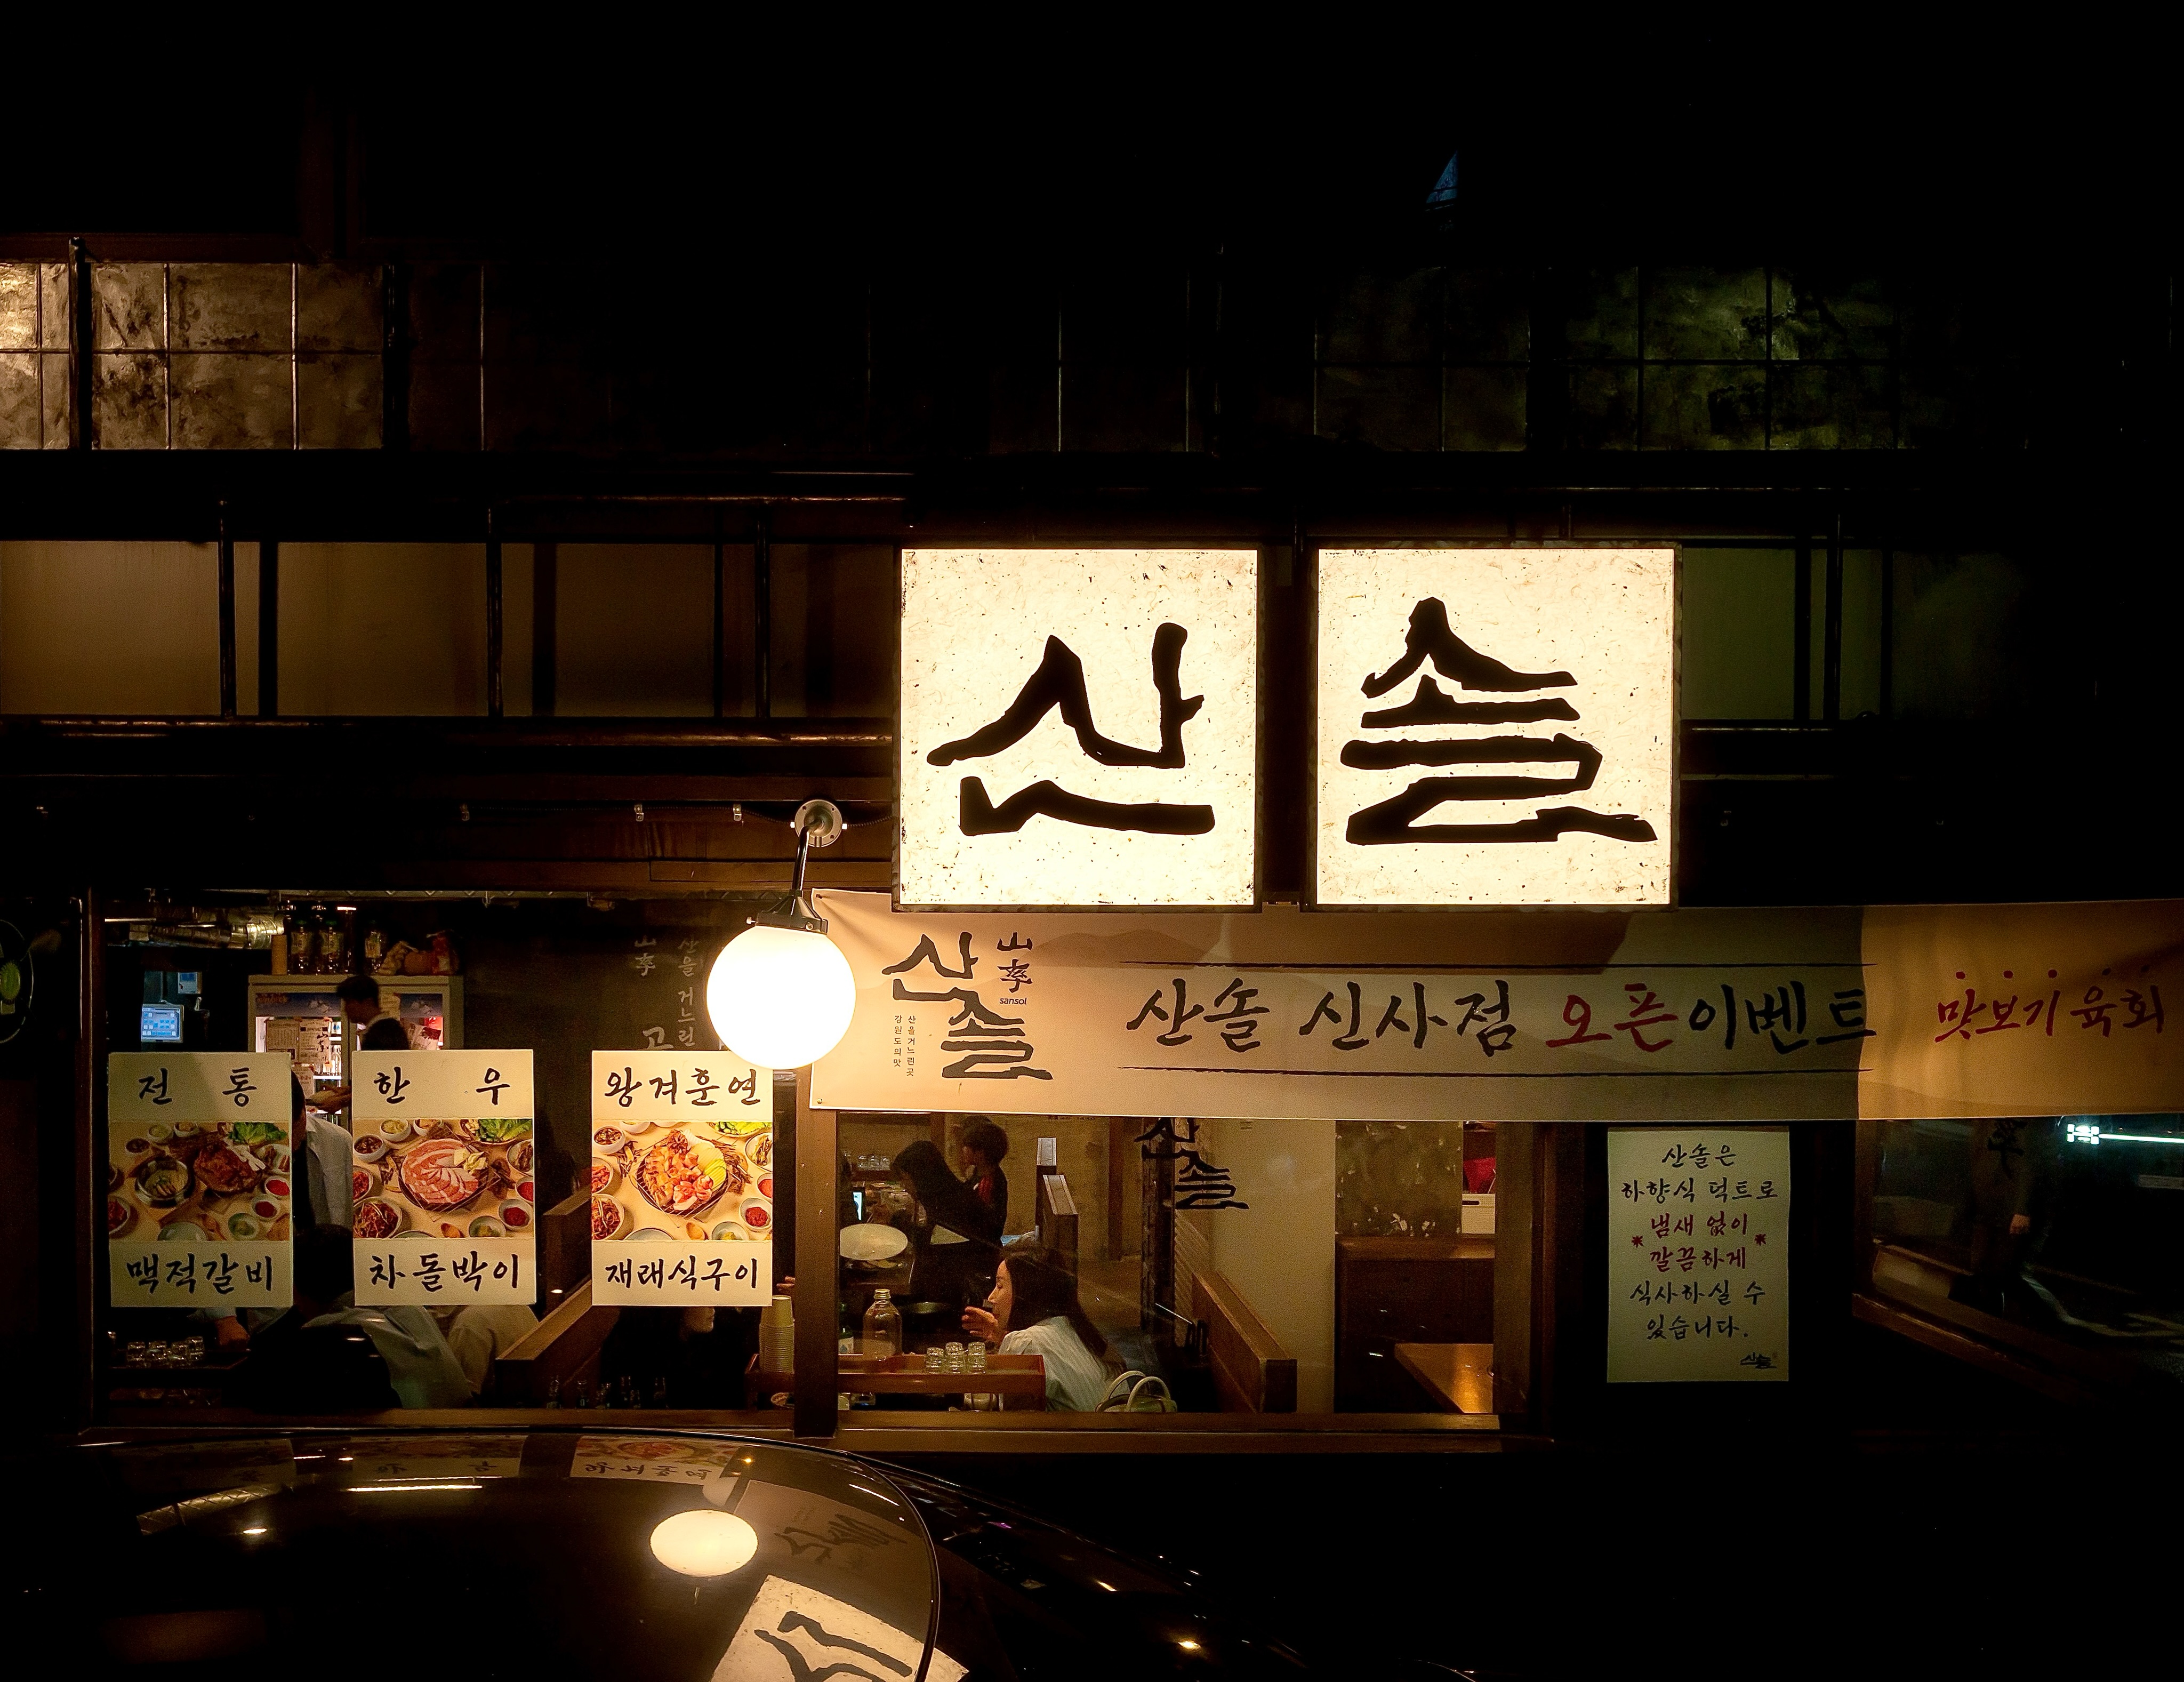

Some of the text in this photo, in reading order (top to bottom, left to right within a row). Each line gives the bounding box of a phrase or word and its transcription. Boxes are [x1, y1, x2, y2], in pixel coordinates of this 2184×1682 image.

[677, 939, 700, 1047] 산을 거느린
[1127, 978, 1270, 1052] 산솔
[1299, 980, 1516, 1057] 신사점
[605, 1067, 760, 1107] 왕겨훈연
[1662, 1143, 1736, 1168] 산솔은
[1621, 1178, 1778, 1204] 하향식 덕트로
[1651, 1211, 1747, 1238] 냄새 없이
[126, 1253, 272, 1294] 맥적갈비
[370, 1251, 518, 1292] 차돌박이
[605, 1255, 757, 1291] 재래식구이
[1650, 1246, 1745, 1272] 깔끔하게
[1630, 1280, 1765, 1305] 식사하실 수
[1647, 1314, 1748, 1340] 있습니다.
